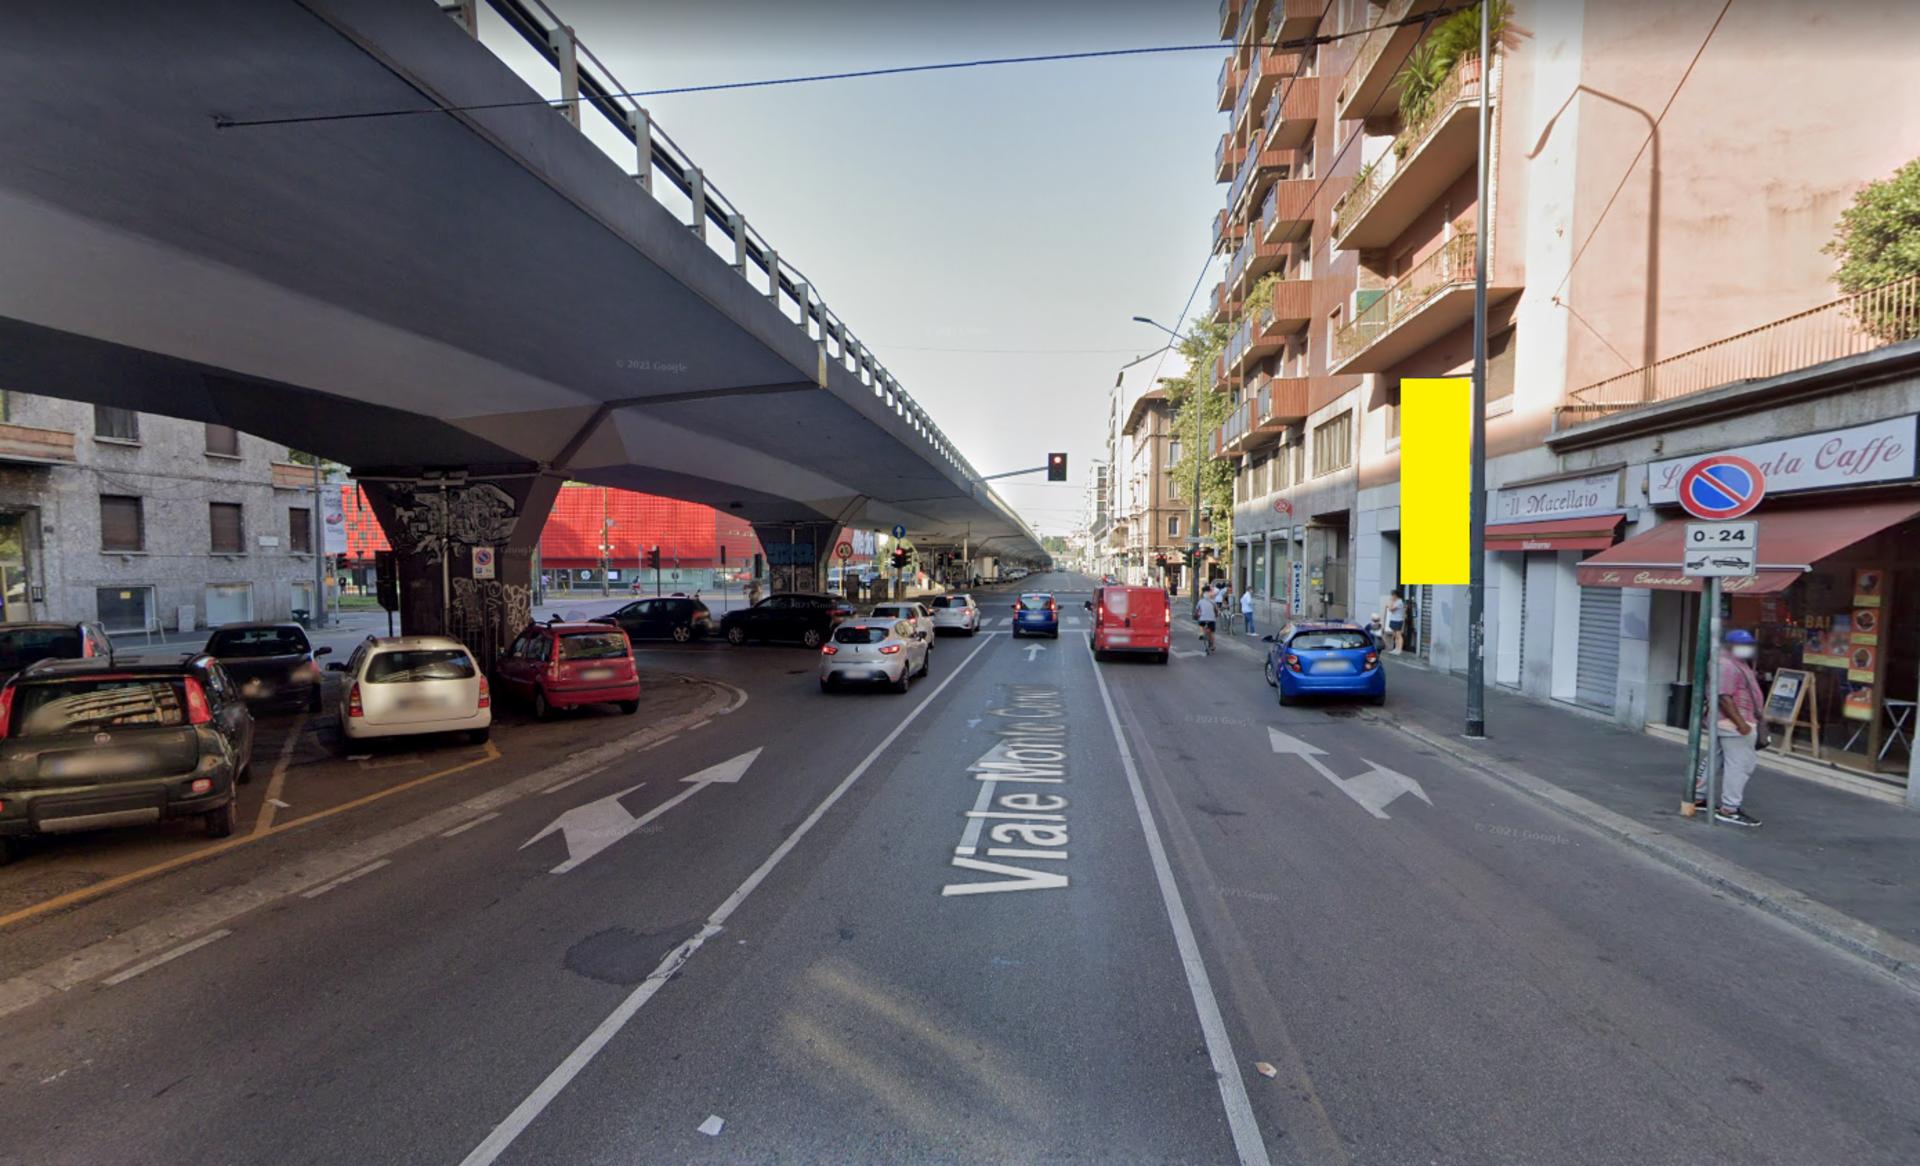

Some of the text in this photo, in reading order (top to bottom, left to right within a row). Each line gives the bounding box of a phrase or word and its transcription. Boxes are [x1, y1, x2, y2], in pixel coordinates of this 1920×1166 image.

[1815, 435, 1905, 476] Caffe
[1527, 490, 1598, 514] Macellaio
[1719, 529, 1746, 542] 24
